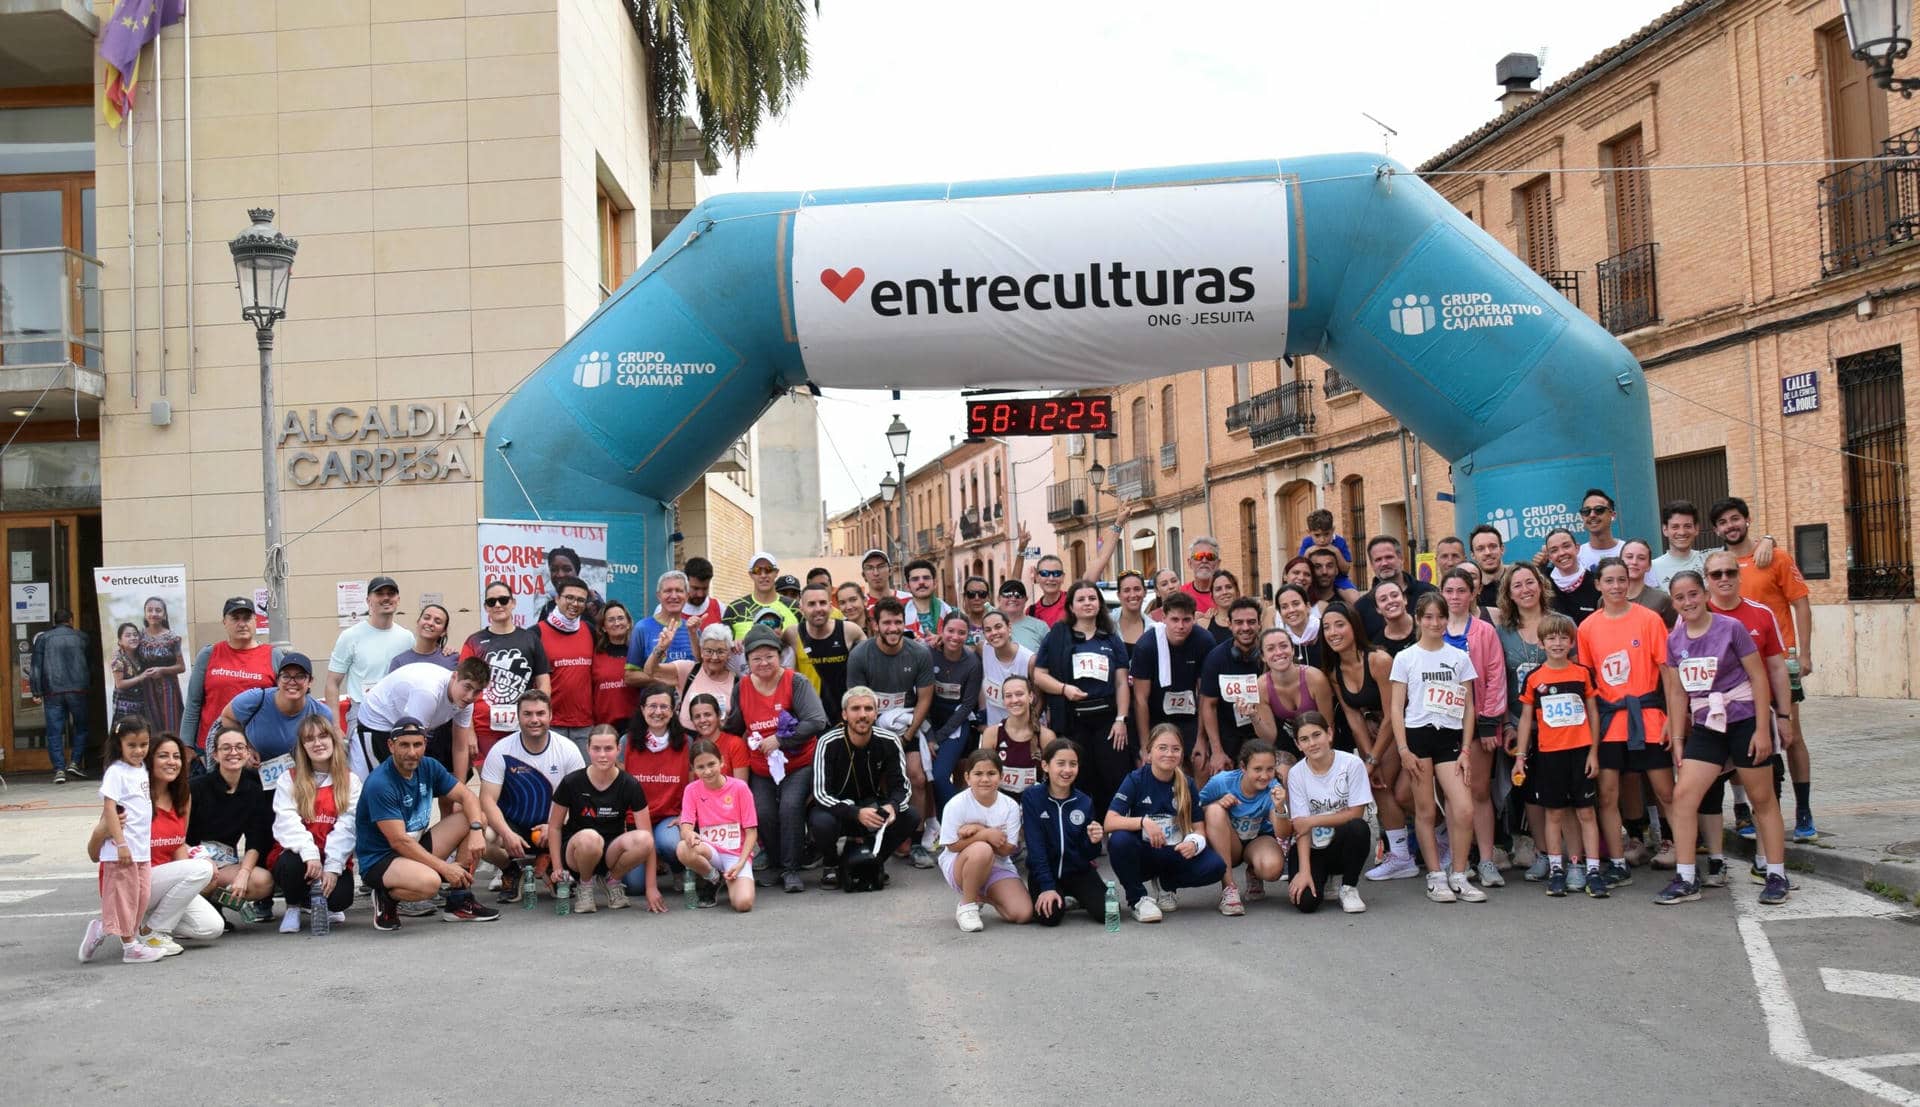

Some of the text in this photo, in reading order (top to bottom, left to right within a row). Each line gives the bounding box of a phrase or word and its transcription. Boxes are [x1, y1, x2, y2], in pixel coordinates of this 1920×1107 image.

[871, 262, 1255, 316] entreculturas
[1441, 293, 1492, 306] GRUPO
[1442, 303, 1542, 318] COOPERATIVO
[1147, 311, 1255, 327] ONG JESUITA
[1443, 315, 1514, 331] CAJAMAR
[617, 351, 665, 363] GRUPO
[616, 363, 717, 375] COOPERATIVO
[616, 374, 684, 388] CAJAMAR
[1786, 373, 1812, 391] CALLE
[279, 401, 480, 444] ALCALDIA
[971, 401, 1107, 434] 58:12:25
[288, 445, 471, 487] CARPESA
[1522, 503, 1566, 517] GRUPO
[1523, 512, 1583, 527] COOPERA
[483, 545, 545, 568] CORRE
[484, 565, 516, 574] POR UNA
[111, 575, 179, 586] entreculturas
[211, 667, 263, 680] entreculturas
[1422, 670, 1452, 682] PUMA
[1683, 666, 1708, 681] 176
[986, 686, 999, 700] 41
[1226, 683, 1241, 695] 68
[1170, 697, 1185, 706] 12
[1428, 688, 1453, 706] 178
[493, 711, 516, 724] 117
[1545, 702, 1573, 718] 345
[262, 763, 284, 782] 321
